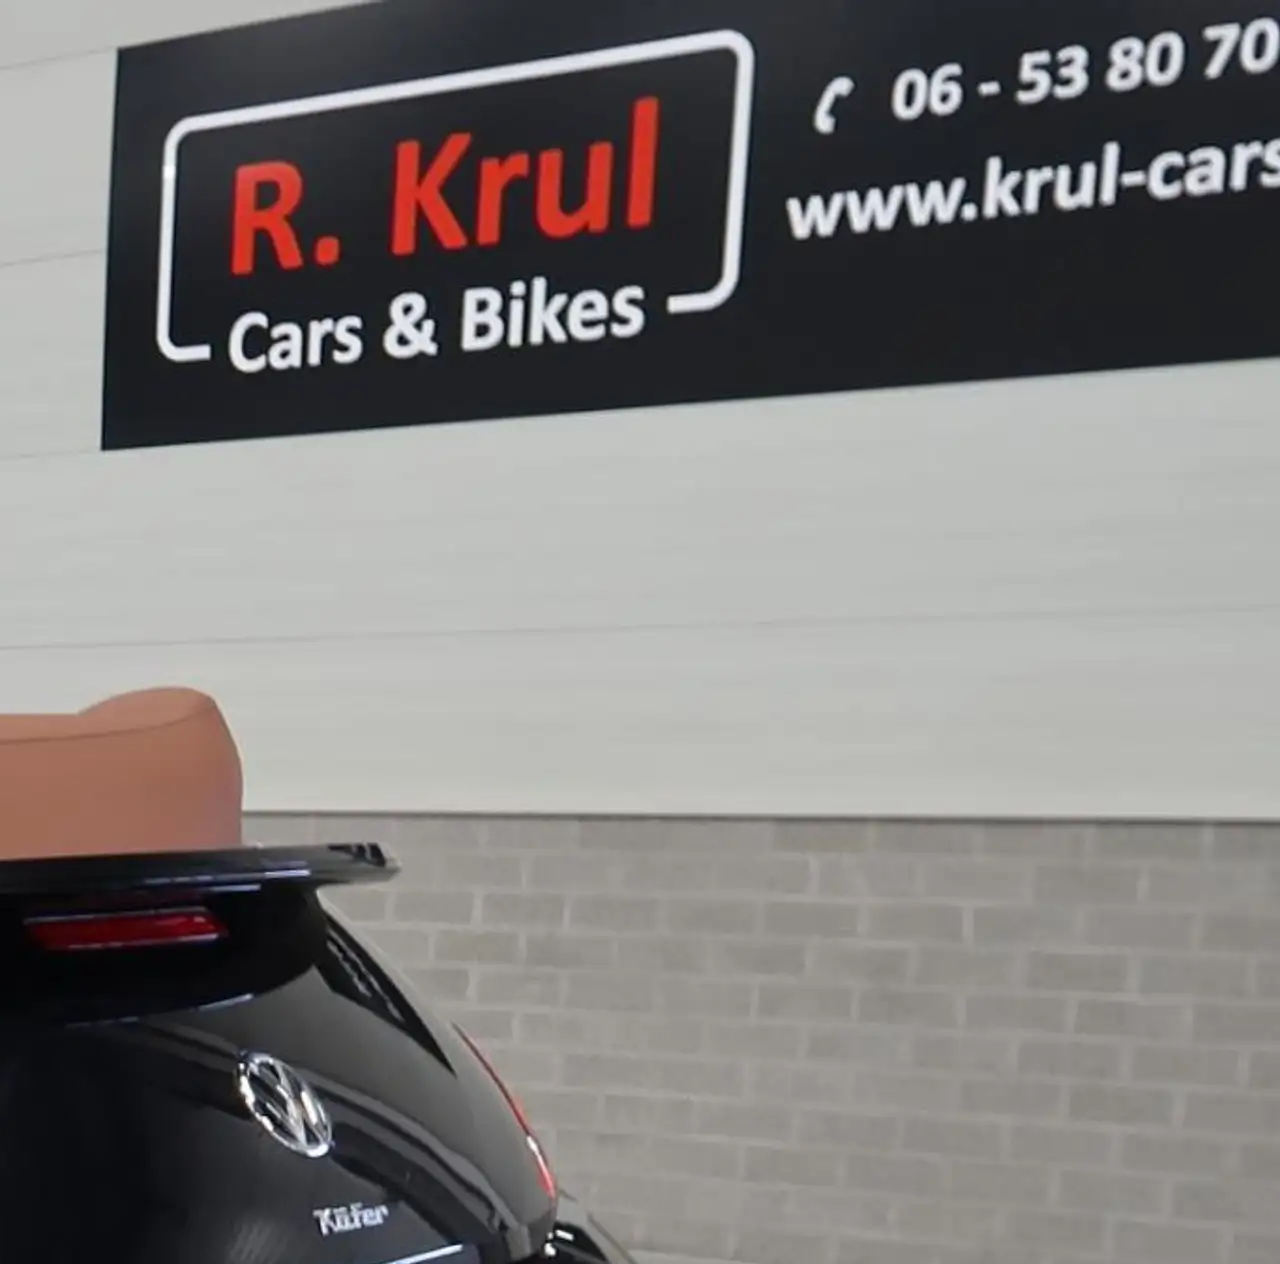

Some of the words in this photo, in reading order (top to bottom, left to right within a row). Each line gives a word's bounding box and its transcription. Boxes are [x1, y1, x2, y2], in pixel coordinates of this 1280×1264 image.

[892, 64, 963, 121] 06
[1015, 45, 1090, 104] 53
[1105, 31, 1185, 91] 80
[1202, 17, 1280, 79] 70
[231, 160, 341, 276] R.
[391, 96, 659, 256] Krul
[228, 311, 363, 373] Cars
[383, 292, 438, 359] &
[461, 276, 645, 352] Bikes
